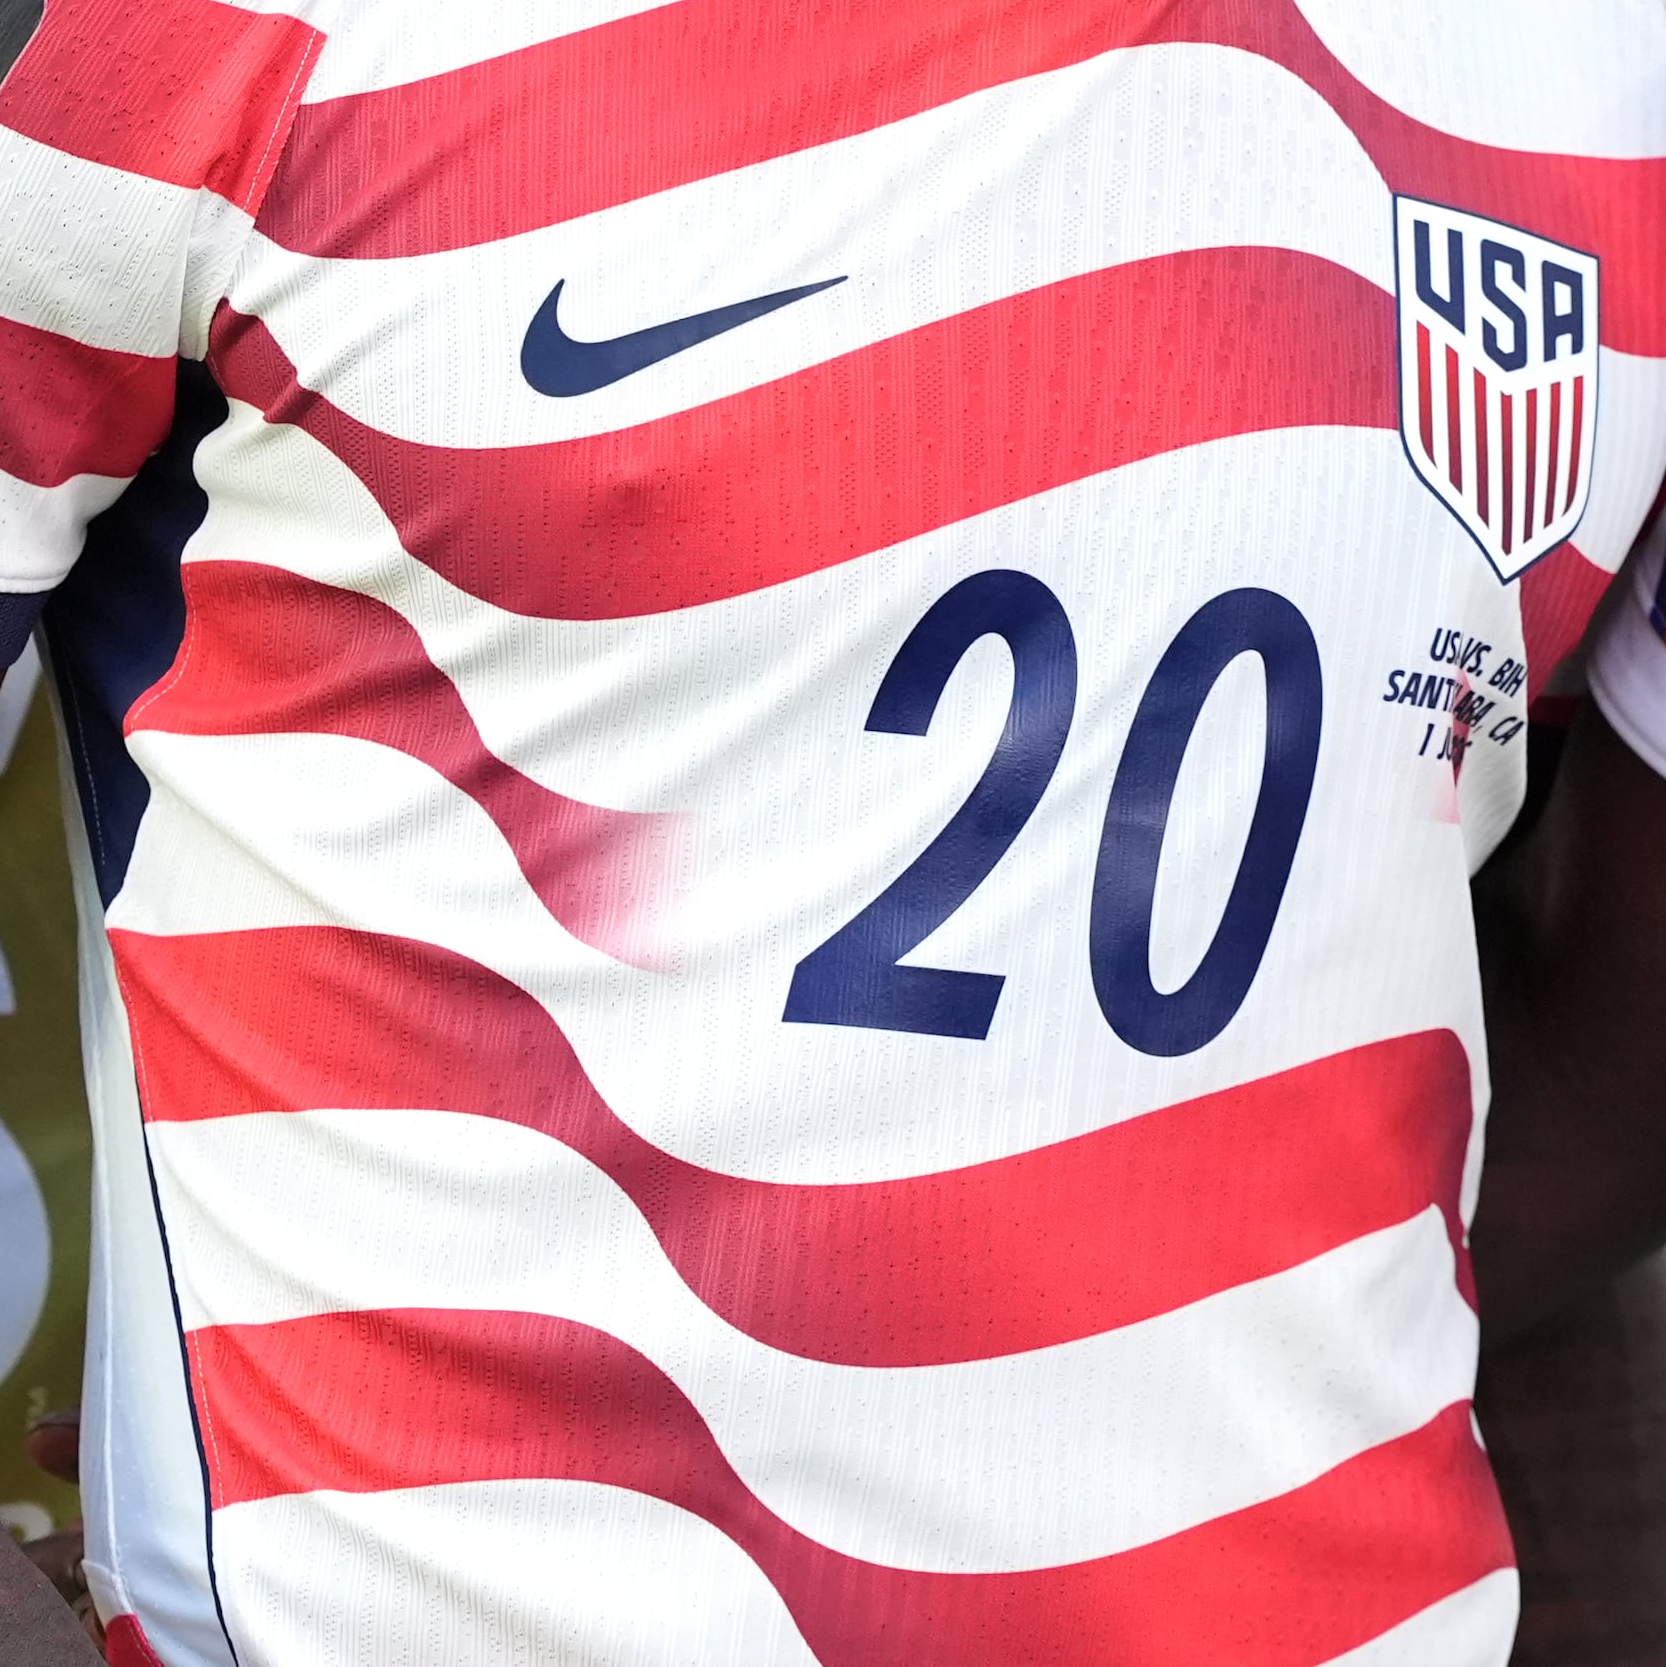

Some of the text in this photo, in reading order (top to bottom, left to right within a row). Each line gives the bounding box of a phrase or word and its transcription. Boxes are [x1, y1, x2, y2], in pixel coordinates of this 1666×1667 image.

[1413, 218, 1584, 372] USA
[1383, 669, 1457, 712] SANT
[1488, 716, 1525, 747] CA
[1430, 627, 1463, 666] US
[1488, 657, 1527, 698] BIH
[781, 568, 1324, 1058] 20
